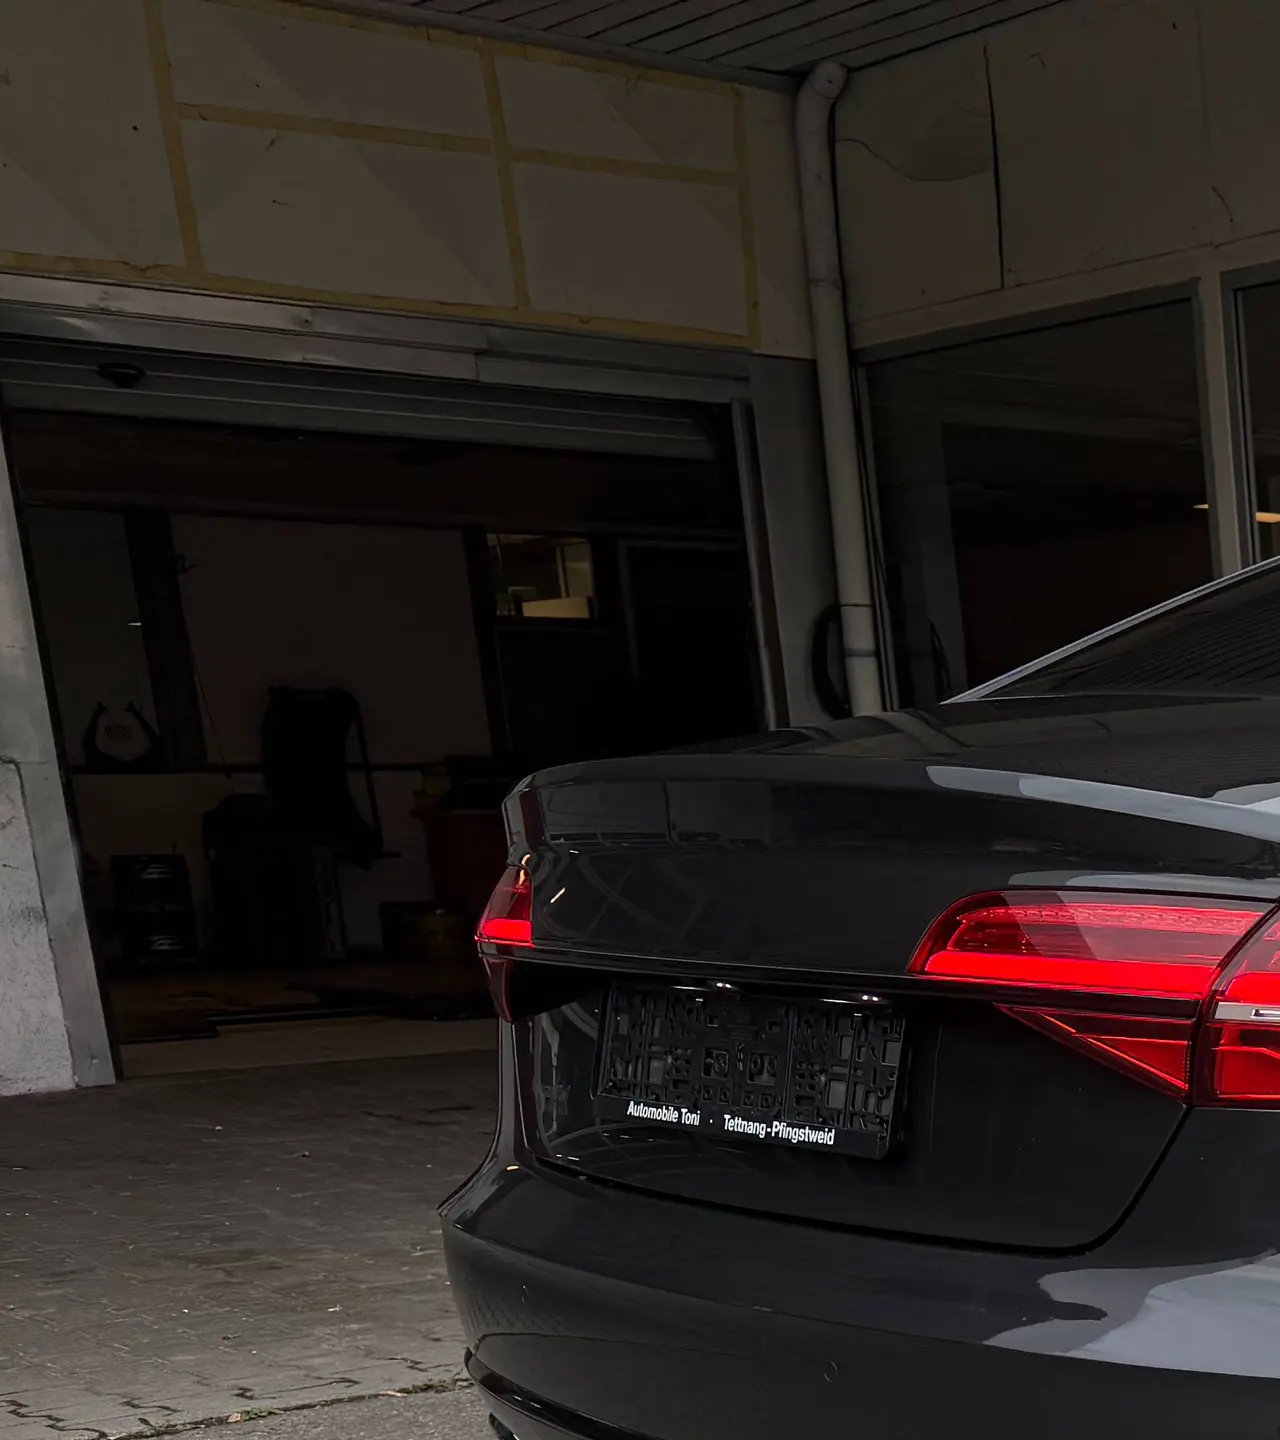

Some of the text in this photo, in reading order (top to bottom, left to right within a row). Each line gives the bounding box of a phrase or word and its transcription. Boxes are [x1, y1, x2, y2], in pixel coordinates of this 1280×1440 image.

[627, 1100, 836, 1146] Automobile Toni Tettnang-Pfingstweid
